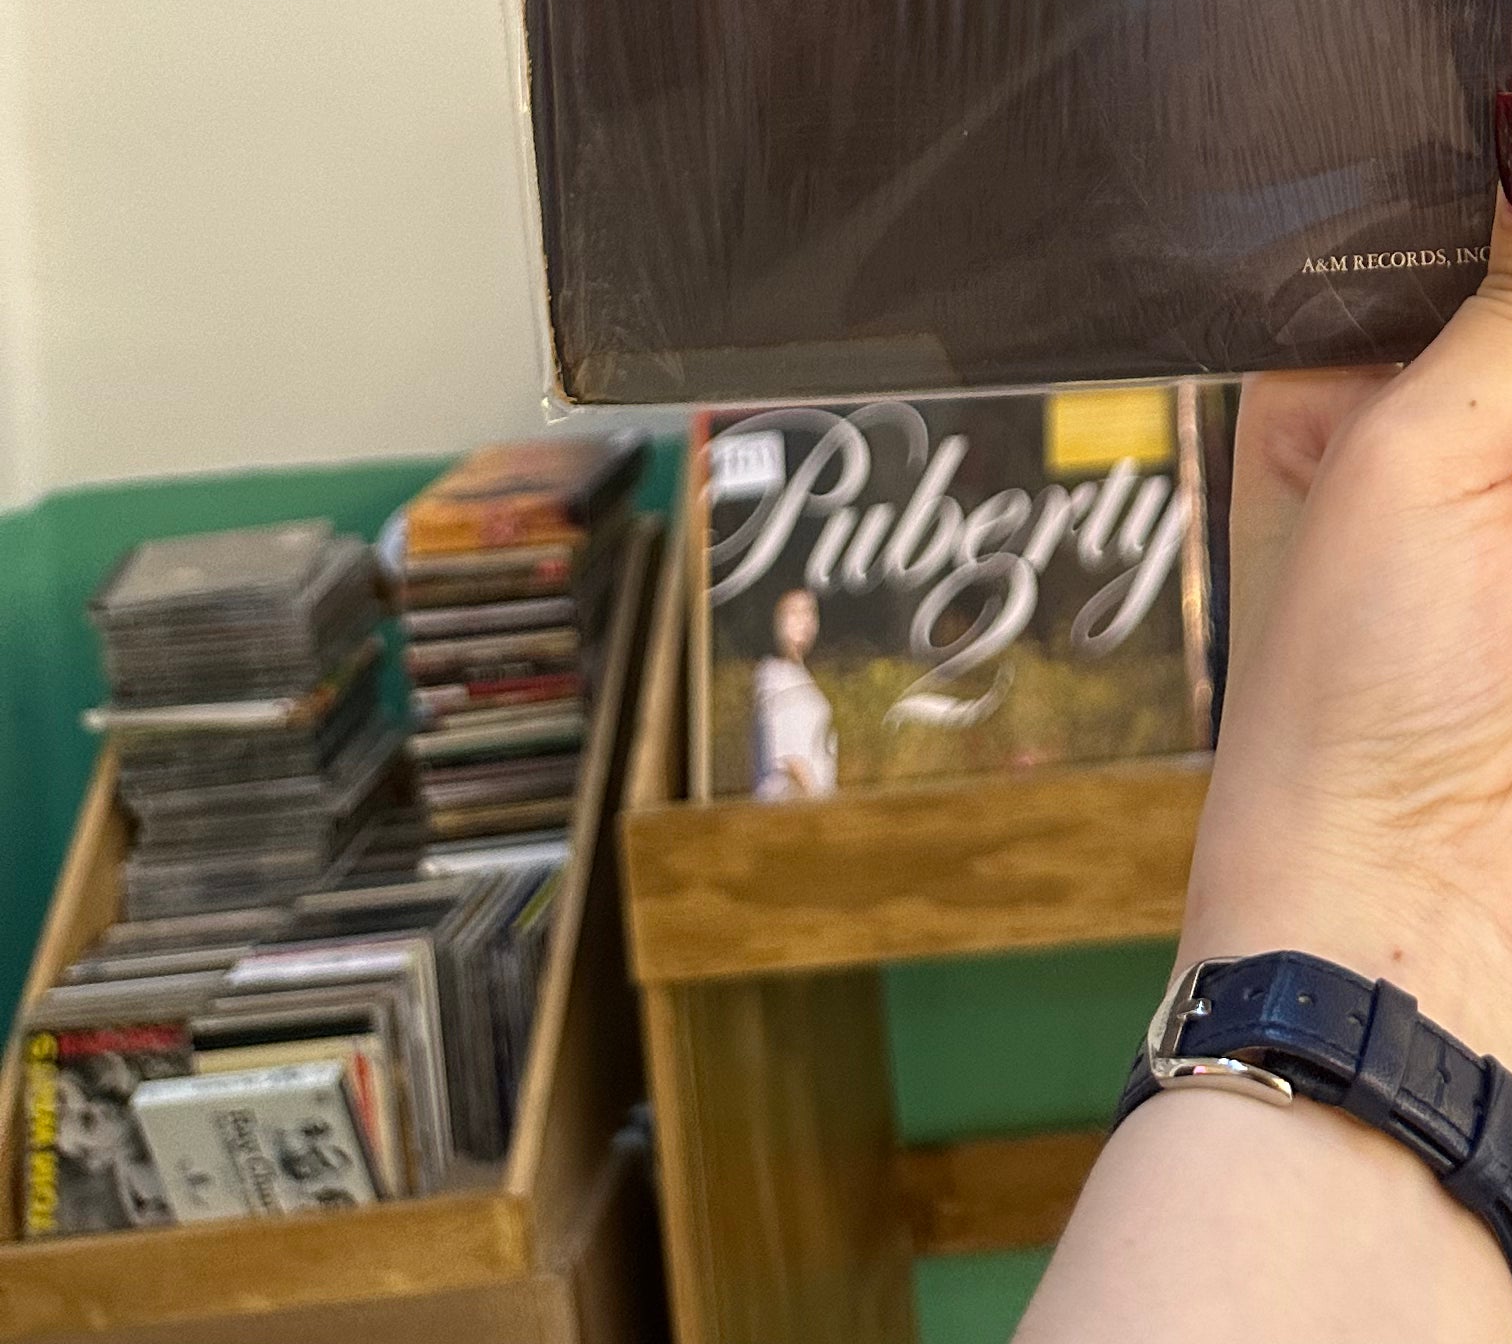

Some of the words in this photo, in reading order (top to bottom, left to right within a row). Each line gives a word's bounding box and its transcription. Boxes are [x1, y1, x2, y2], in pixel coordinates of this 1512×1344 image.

[1302, 255, 1348, 273] A&M
[1352, 248, 1450, 270] RECORDS,
[702, 401, 1193, 659] Puberty
